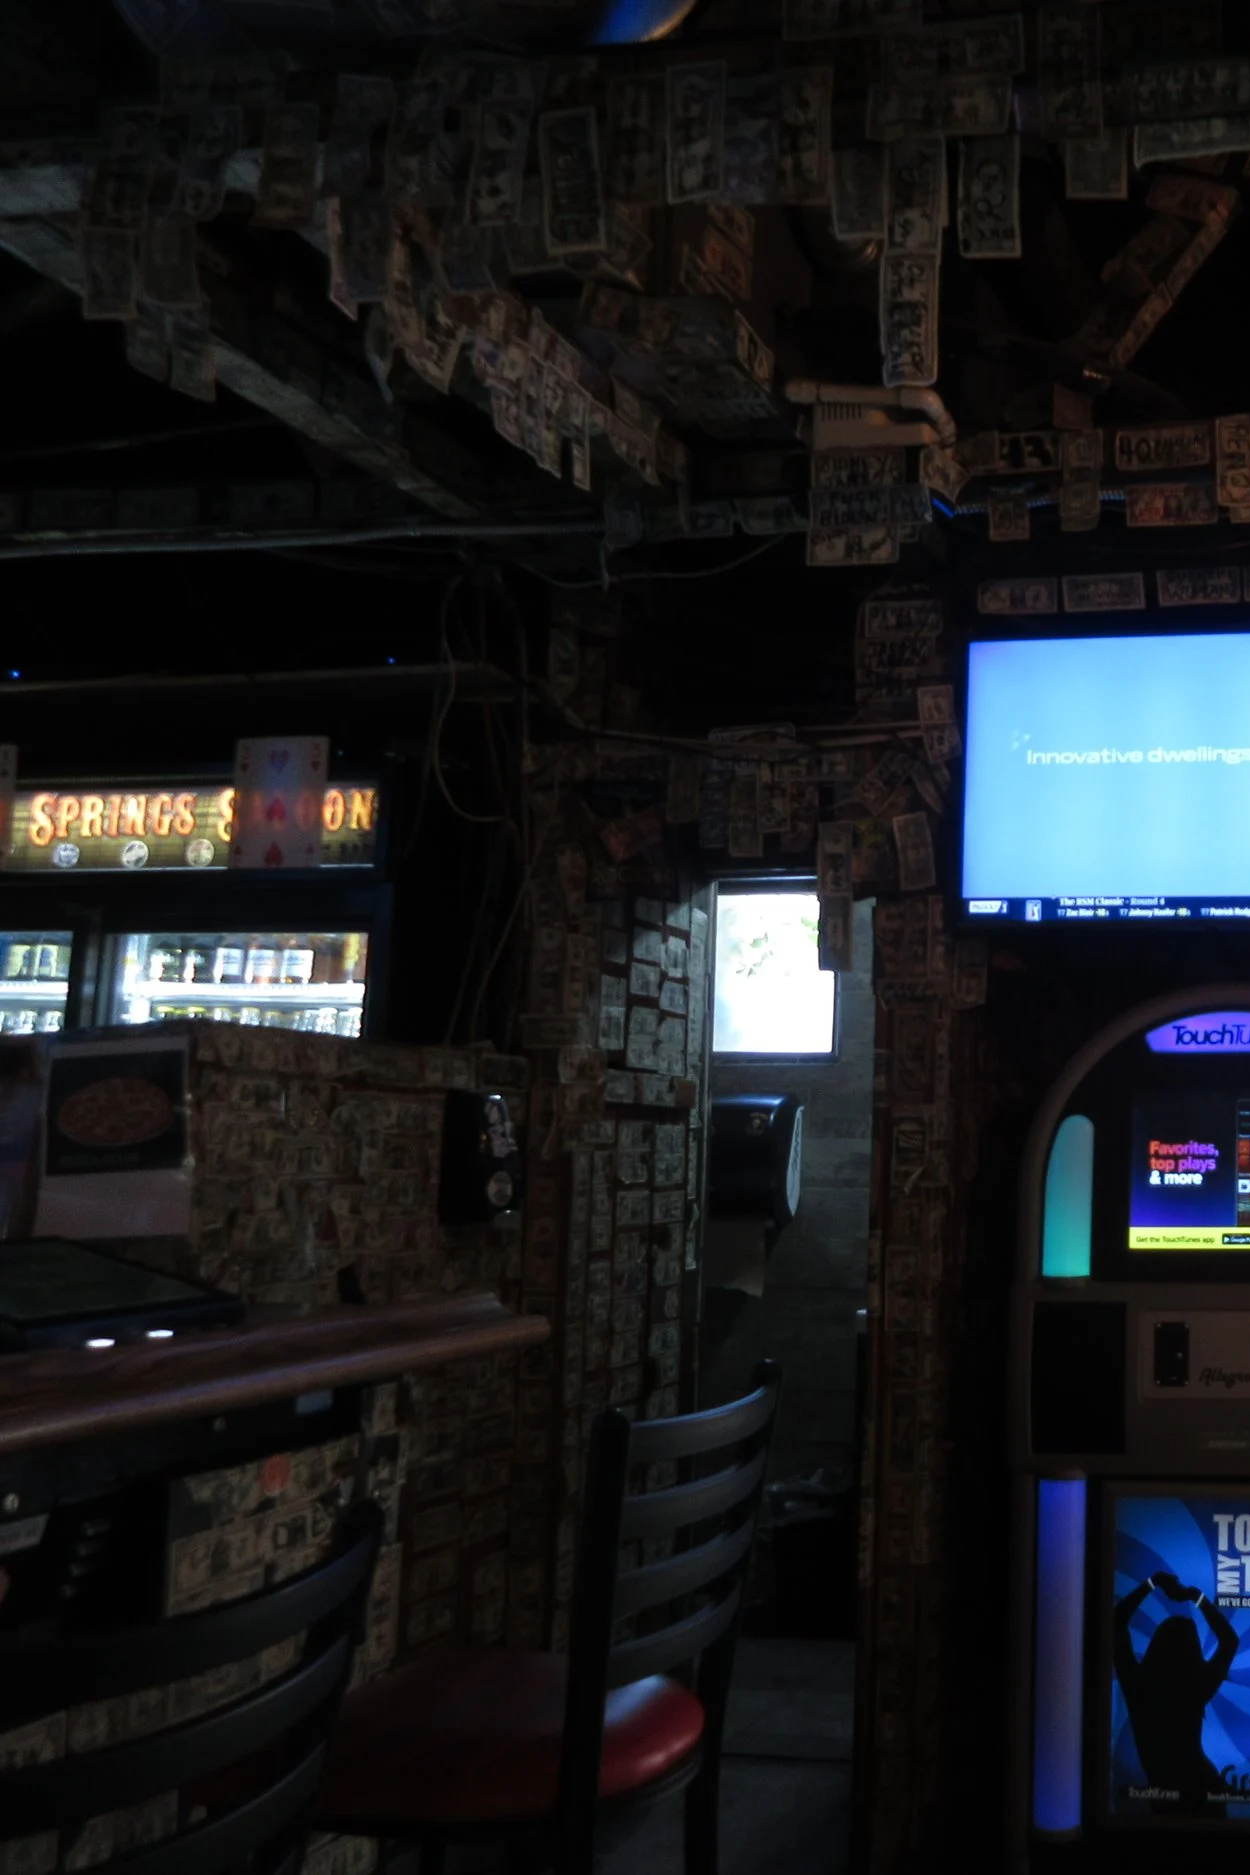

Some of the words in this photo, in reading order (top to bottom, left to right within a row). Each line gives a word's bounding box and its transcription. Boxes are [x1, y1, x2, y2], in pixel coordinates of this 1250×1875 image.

[1027, 748, 1144, 765] Innovative
[28, 791, 197, 847] SPRINGS
[217, 787, 375, 842] SON
[1060, 897, 1075, 906] The
[1095, 897, 1124, 906] Classic
[1130, 897, 1158, 906] Round
[1149, 1140, 1219, 1156] Favorites,
[1150, 1157, 1175, 1172] top
[1178, 1156, 1216, 1173] plays
[1149, 1170, 1161, 1185] &
[1164, 1173, 1203, 1185] more
[1150, 1235, 1160, 1243] the
[1163, 1234, 1200, 1243] TouchTunes
[1202, 1237, 1215, 1245] app
[1231, 1236, 1247, 1245] Google
[1217, 1554, 1240, 1594] MY
[1218, 1597, 1240, 1608] WE'VE
